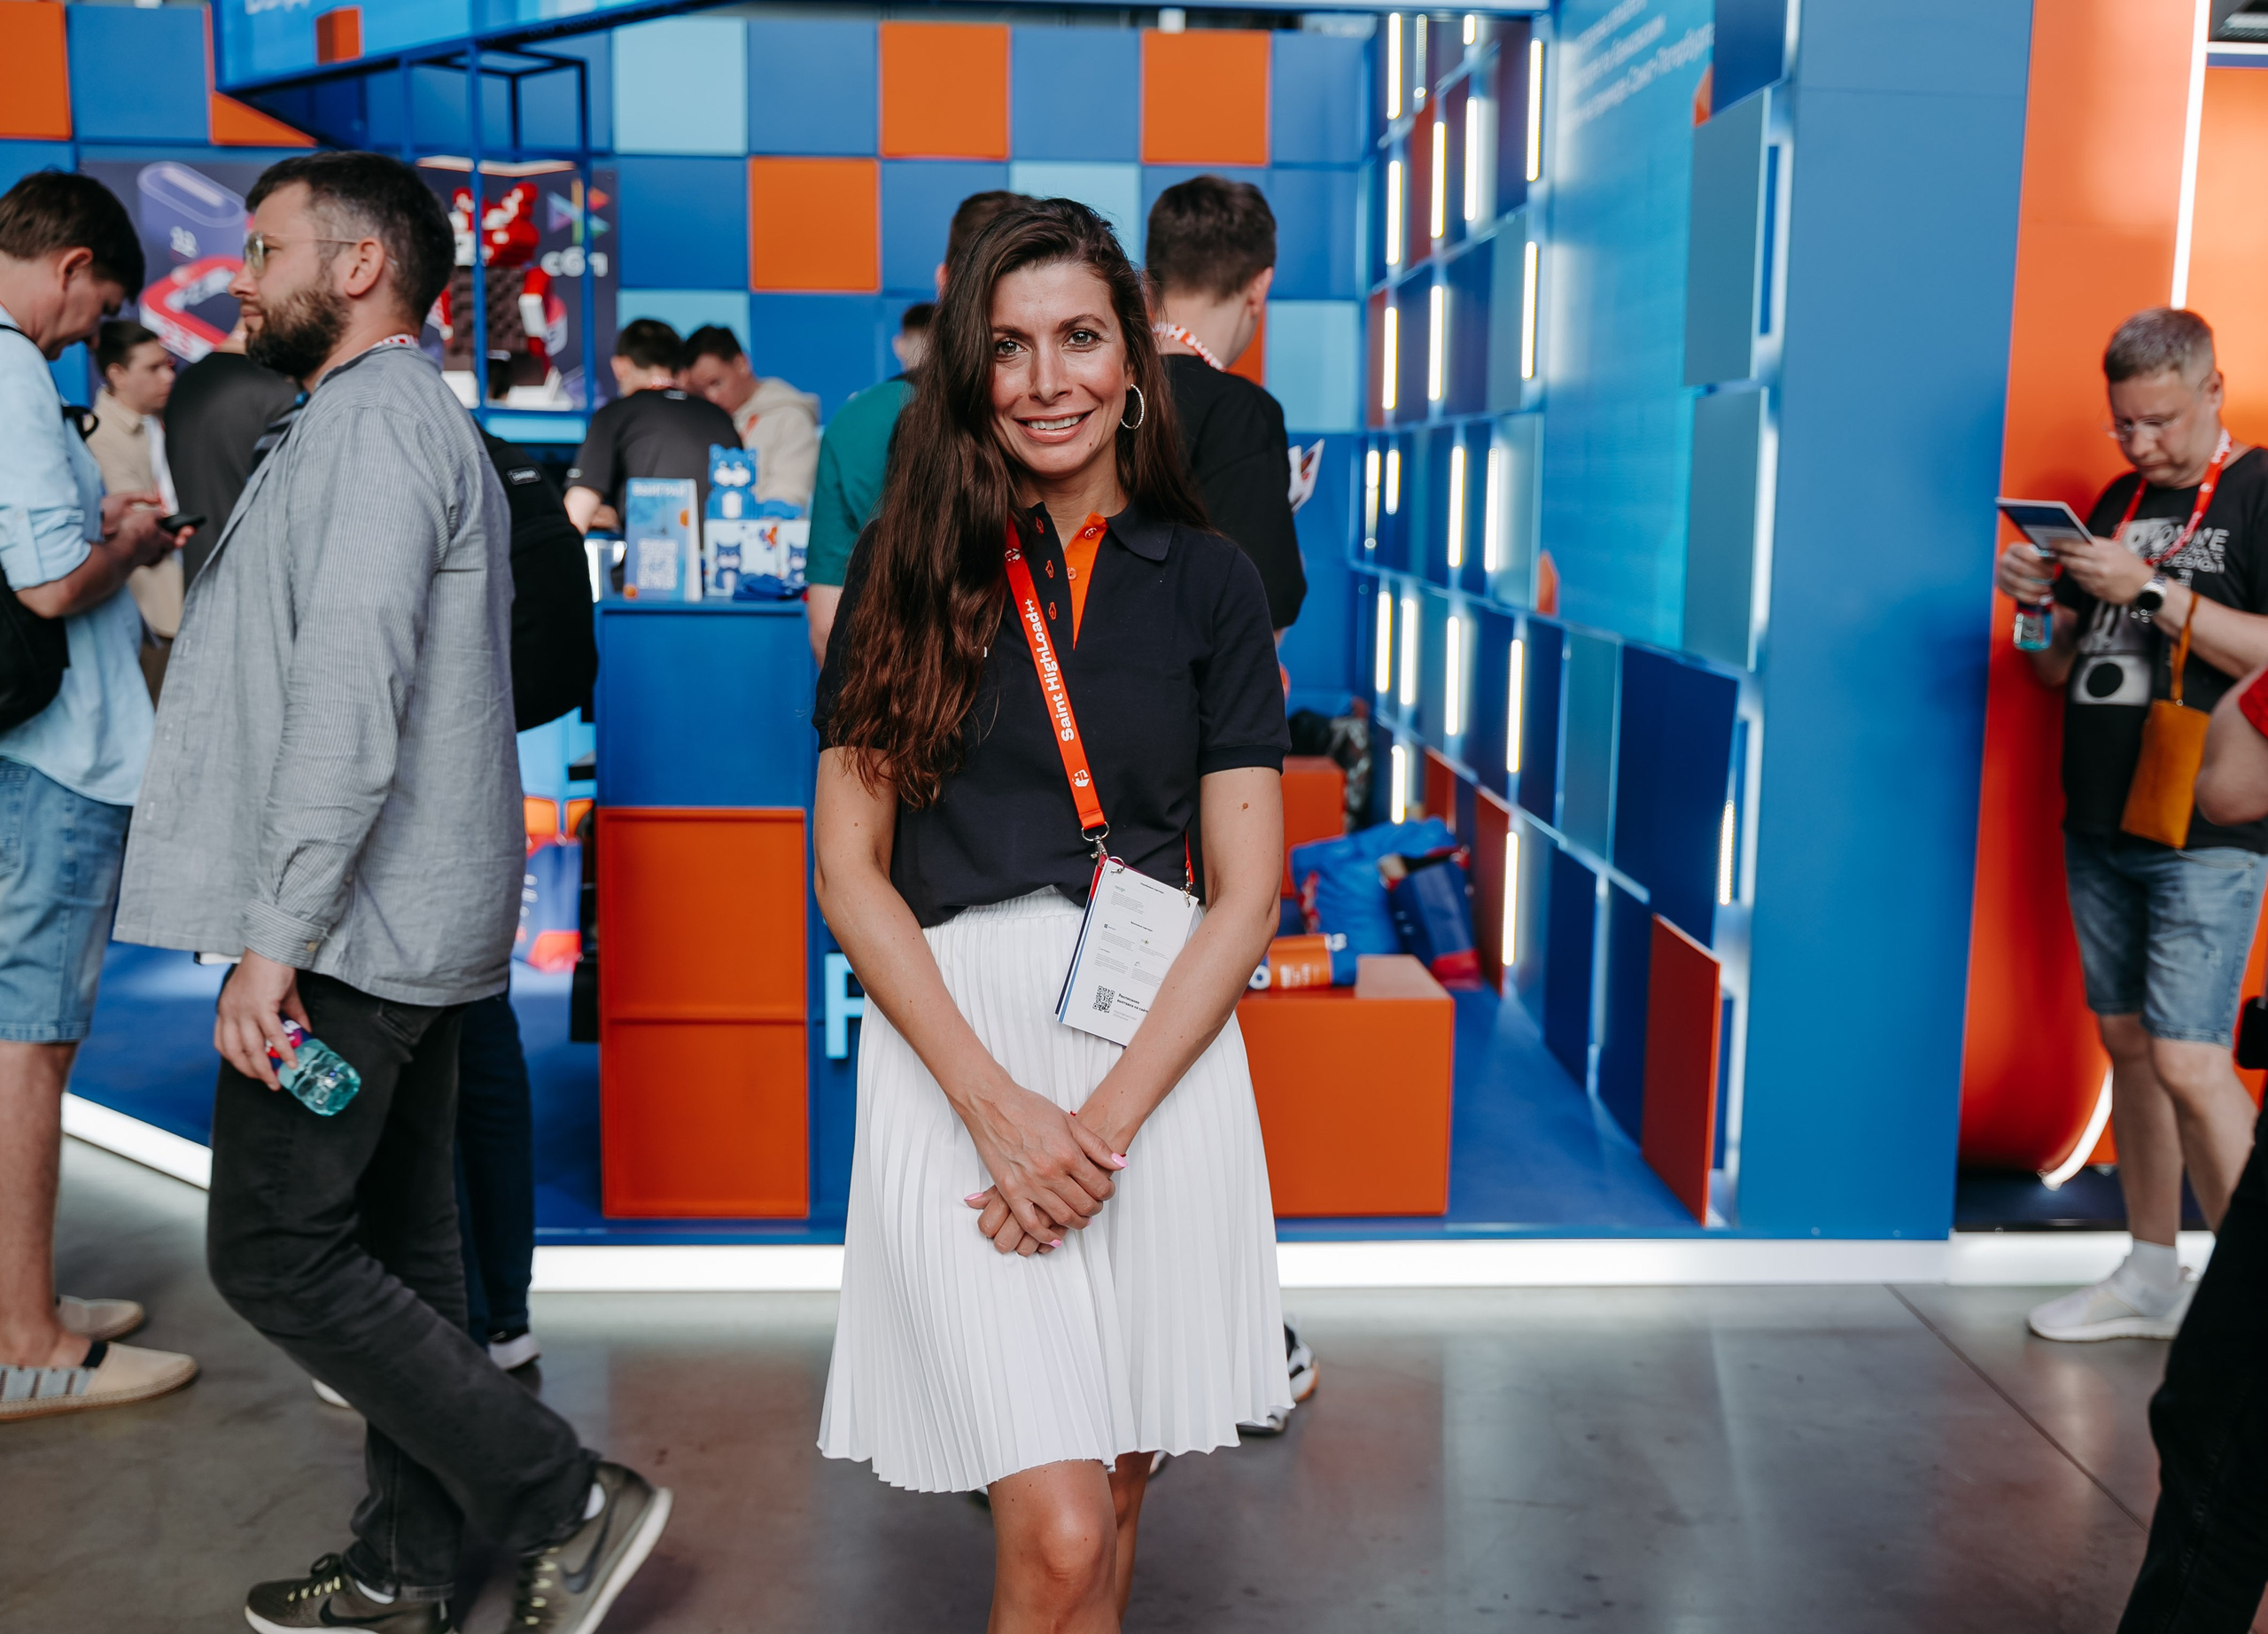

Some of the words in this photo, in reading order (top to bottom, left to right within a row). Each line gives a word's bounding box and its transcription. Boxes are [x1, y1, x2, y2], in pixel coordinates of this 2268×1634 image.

[1024, 598, 1060, 691] HighLoad++
[1052, 692, 1076, 742] Saint
[1118, 993, 1140, 1004] Расписание
